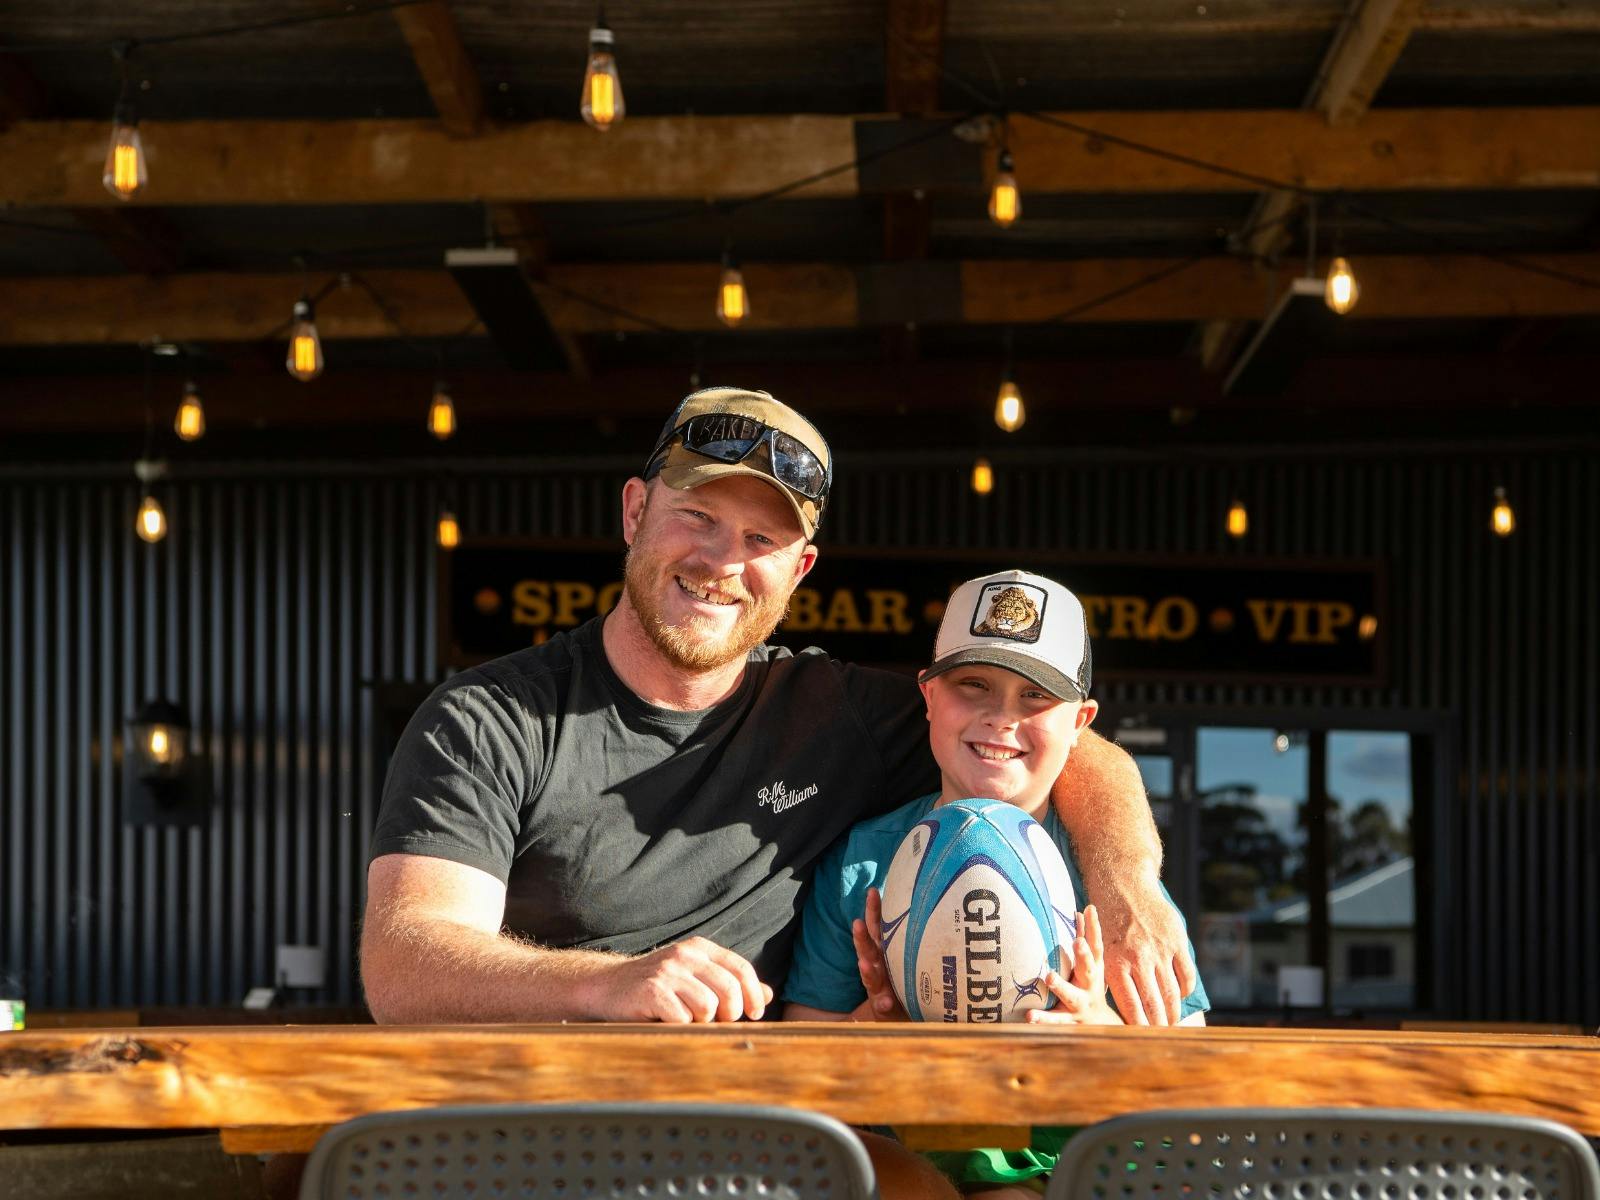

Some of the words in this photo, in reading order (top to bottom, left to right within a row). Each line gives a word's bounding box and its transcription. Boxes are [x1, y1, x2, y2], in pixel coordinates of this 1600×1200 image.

[512, 579, 624, 625] SP
[780, 587, 914, 634] BAR
[1081, 593, 1198, 641] TRO
[1244, 597, 1355, 643] VIP
[772, 783, 818, 814] Williams
[962, 888, 1004, 1023] GILBE
